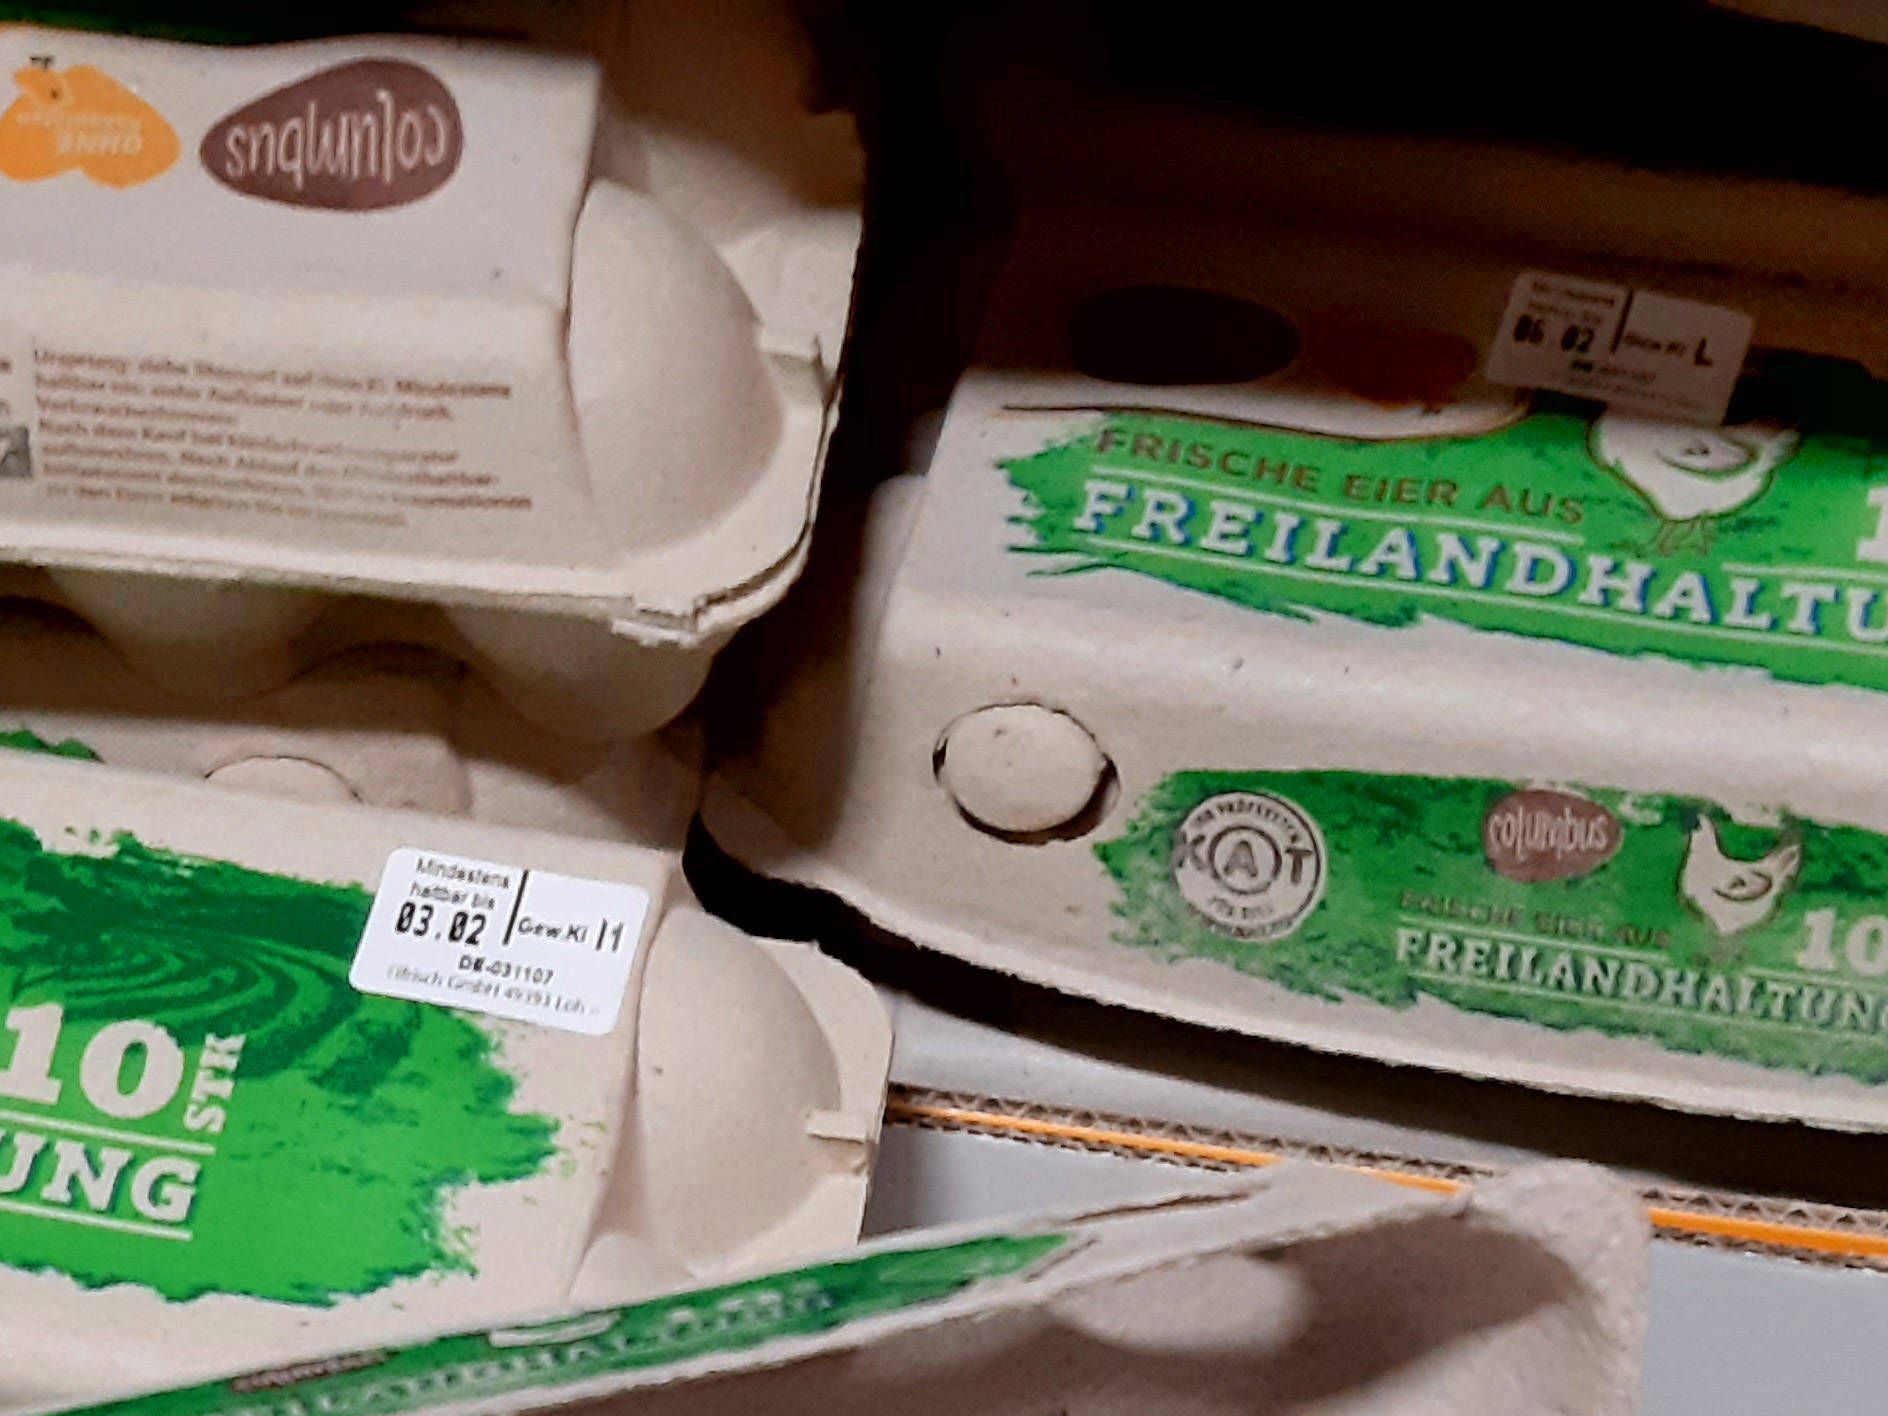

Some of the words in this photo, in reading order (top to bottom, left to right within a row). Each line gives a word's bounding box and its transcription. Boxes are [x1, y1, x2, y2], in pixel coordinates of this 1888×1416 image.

[224, 100, 449, 186] columbus
[1692, 336, 1714, 368] L
[1093, 427, 1321, 496] FRISCHE
[1341, 468, 1460, 507] EIER
[1482, 482, 1588, 528] AUS
[1487, 810, 1609, 861] columbus
[393, 901, 489, 947] 03.02
[185, 1030, 248, 1135] STK
